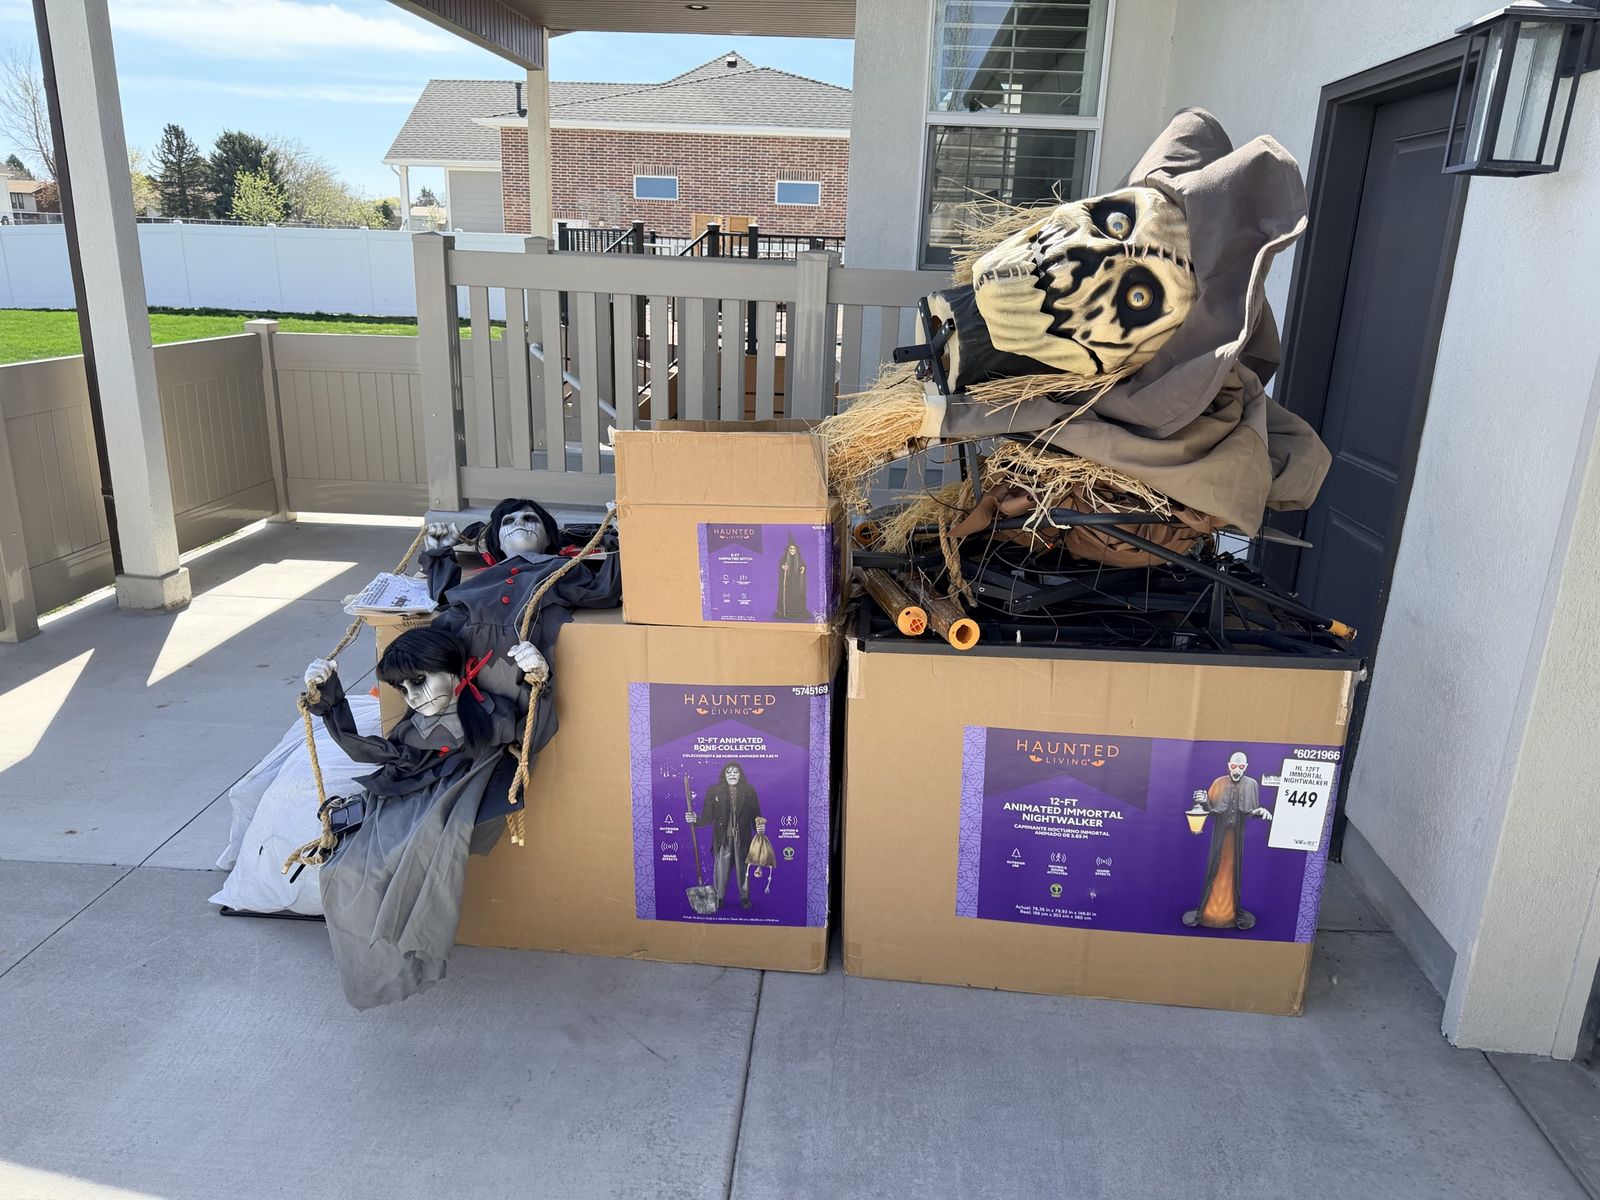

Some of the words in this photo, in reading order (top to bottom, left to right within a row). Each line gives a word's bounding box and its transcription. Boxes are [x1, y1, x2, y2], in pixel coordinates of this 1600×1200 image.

[684, 694, 776, 706] HAUNTED
[711, 707, 749, 715] LIVING
[1016, 739, 1120, 757] HAUNTED
[1045, 757, 1088, 766] LIVING
[1289, 771, 1323, 779] IMMORTAL
[1283, 777, 1328, 786] NIGHTWALKER
[1049, 797, 1078, 807] 12-FT
[1285, 789, 1318, 808] $449
[1003, 802, 1062, 814] ANIMATED
[1063, 808, 1124, 820] IMMORTAL
[1022, 813, 1103, 828] NIGHTWALKER
[1013, 823, 1047, 831] CAMINANTE
